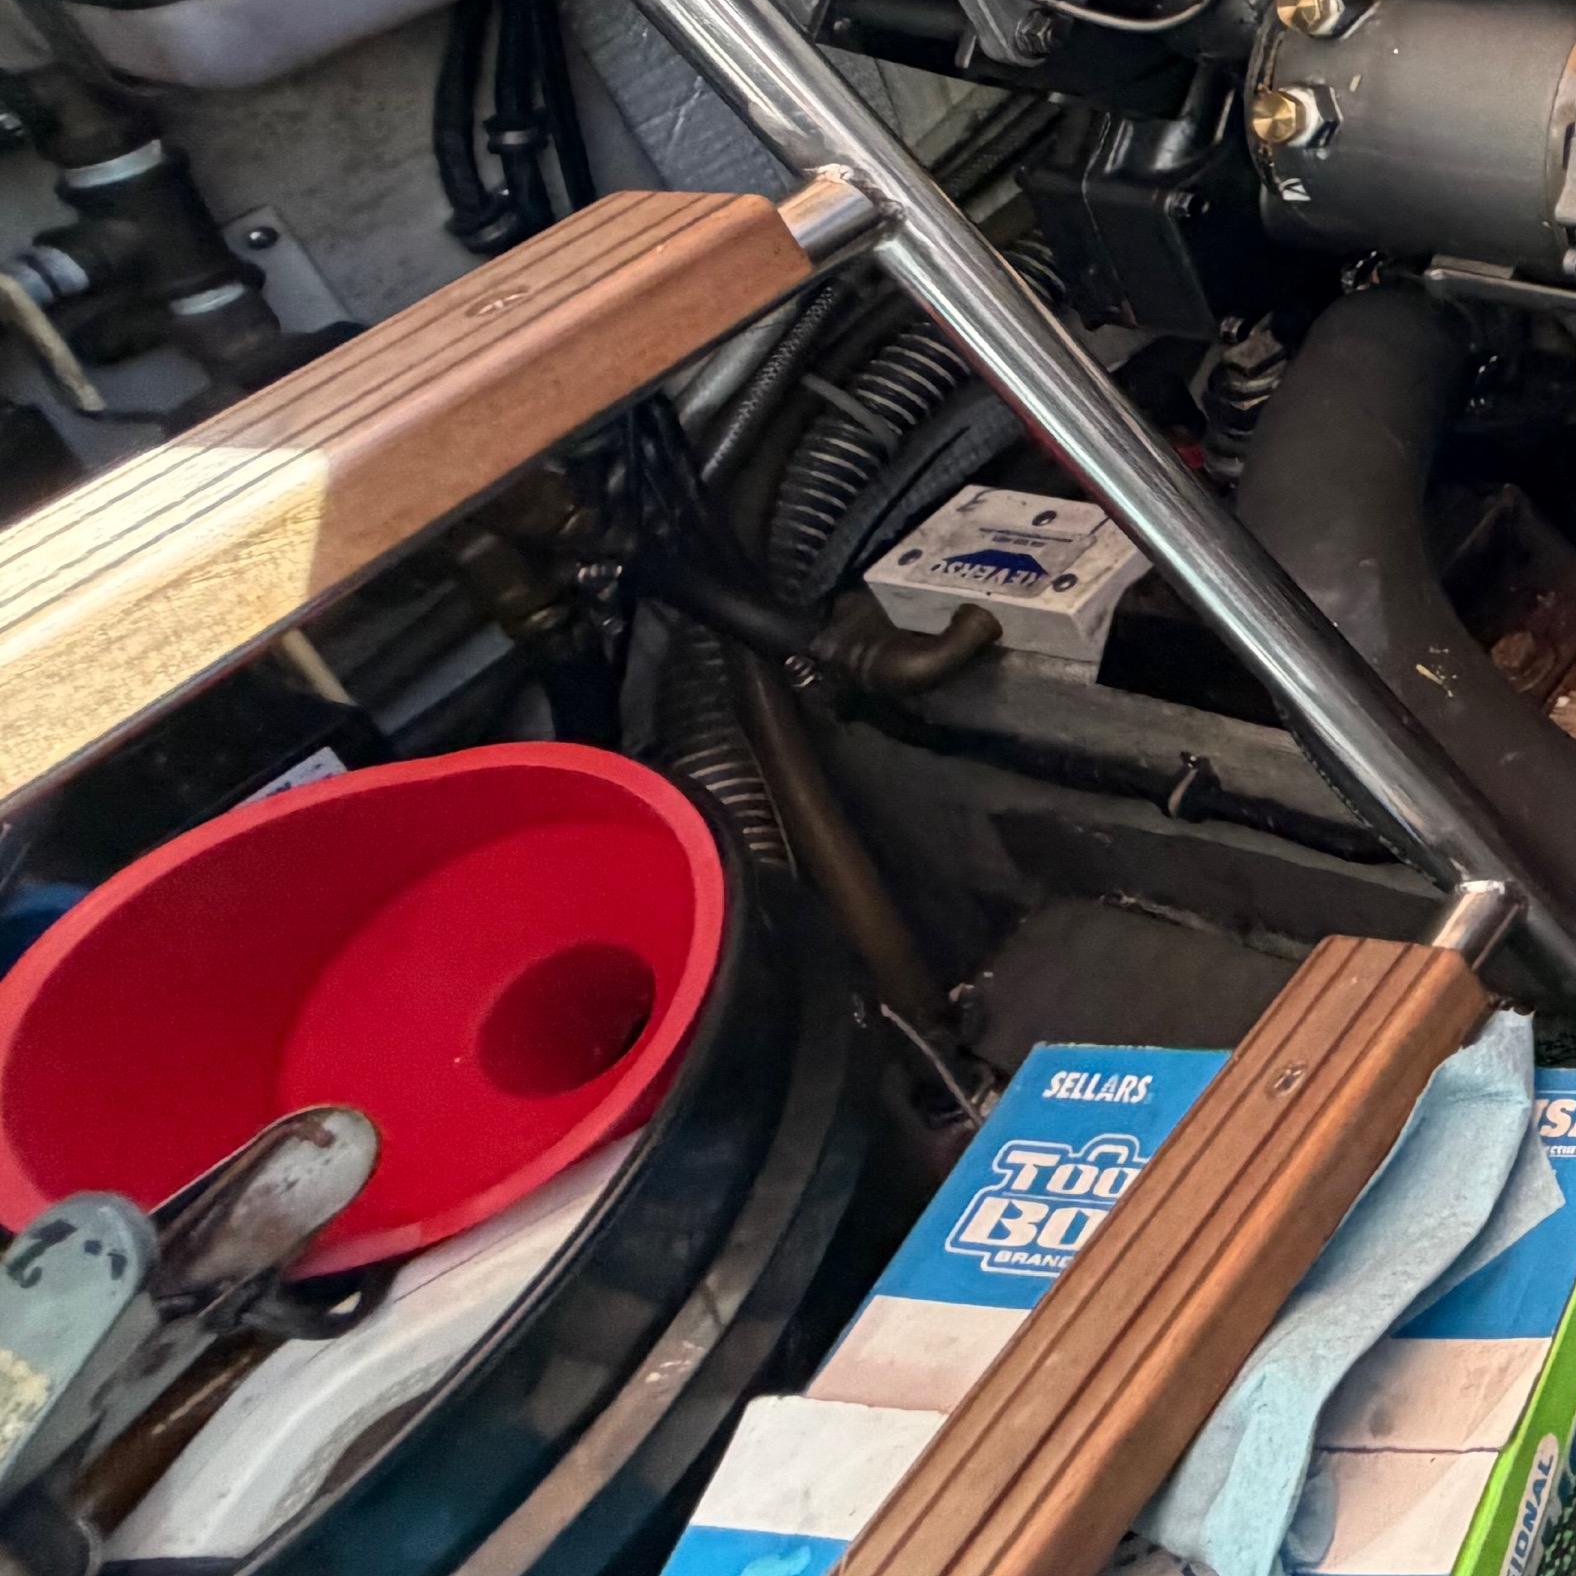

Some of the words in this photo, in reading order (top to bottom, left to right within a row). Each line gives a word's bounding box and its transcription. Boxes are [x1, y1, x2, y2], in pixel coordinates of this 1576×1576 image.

[1042, 1070, 1154, 1104] SELLARS
[1006, 1150, 1142, 1199] TOO
[958, 1196, 1110, 1251] BO
[1507, 1454, 1555, 1576] IONAL
